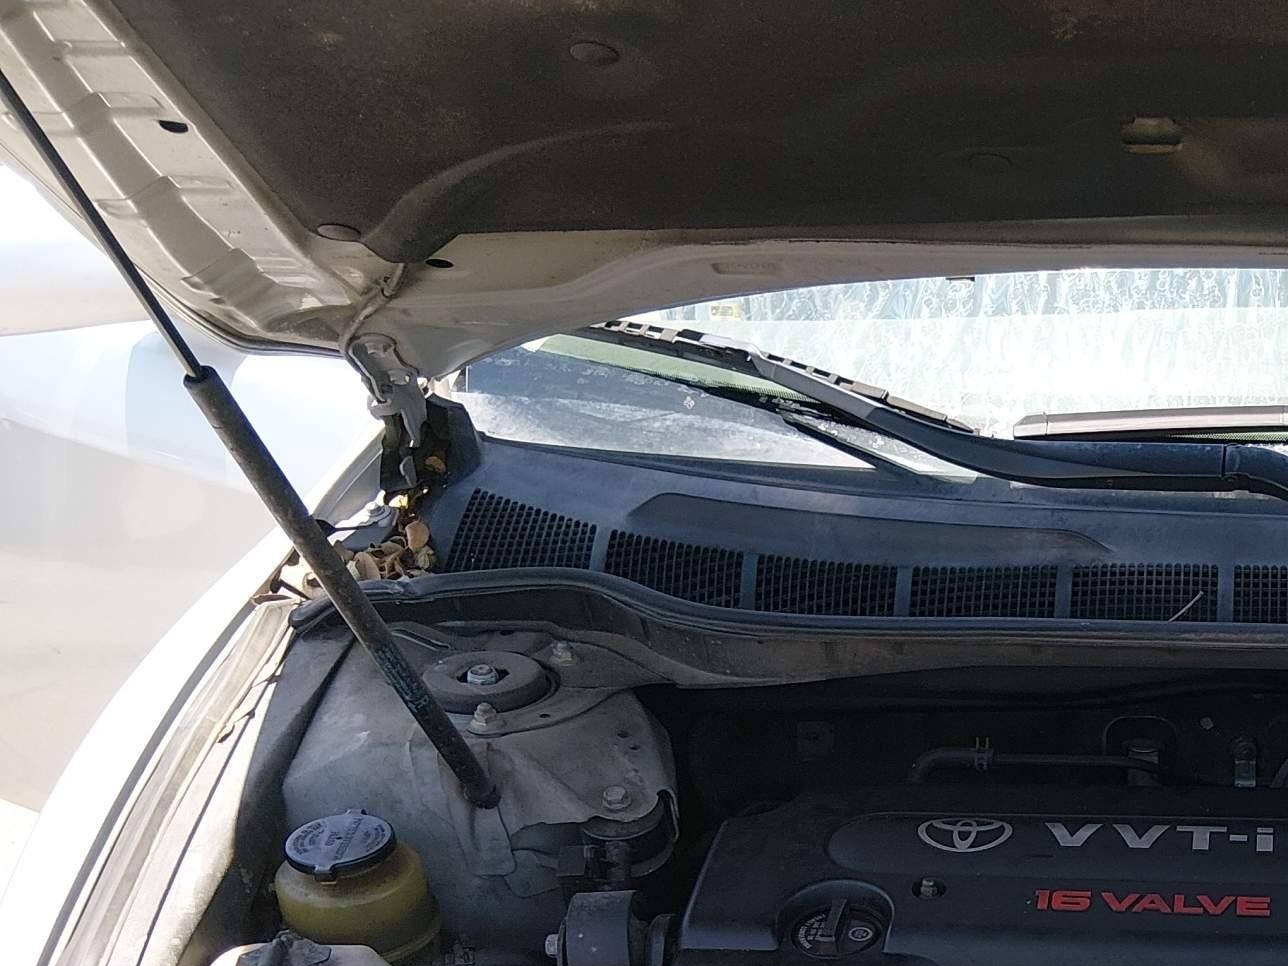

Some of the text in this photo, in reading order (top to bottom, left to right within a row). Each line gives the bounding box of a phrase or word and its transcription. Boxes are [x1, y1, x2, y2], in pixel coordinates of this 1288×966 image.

[1045, 822, 1274, 852] VVT-i
[1035, 889, 1271, 916] 16 VALVE
